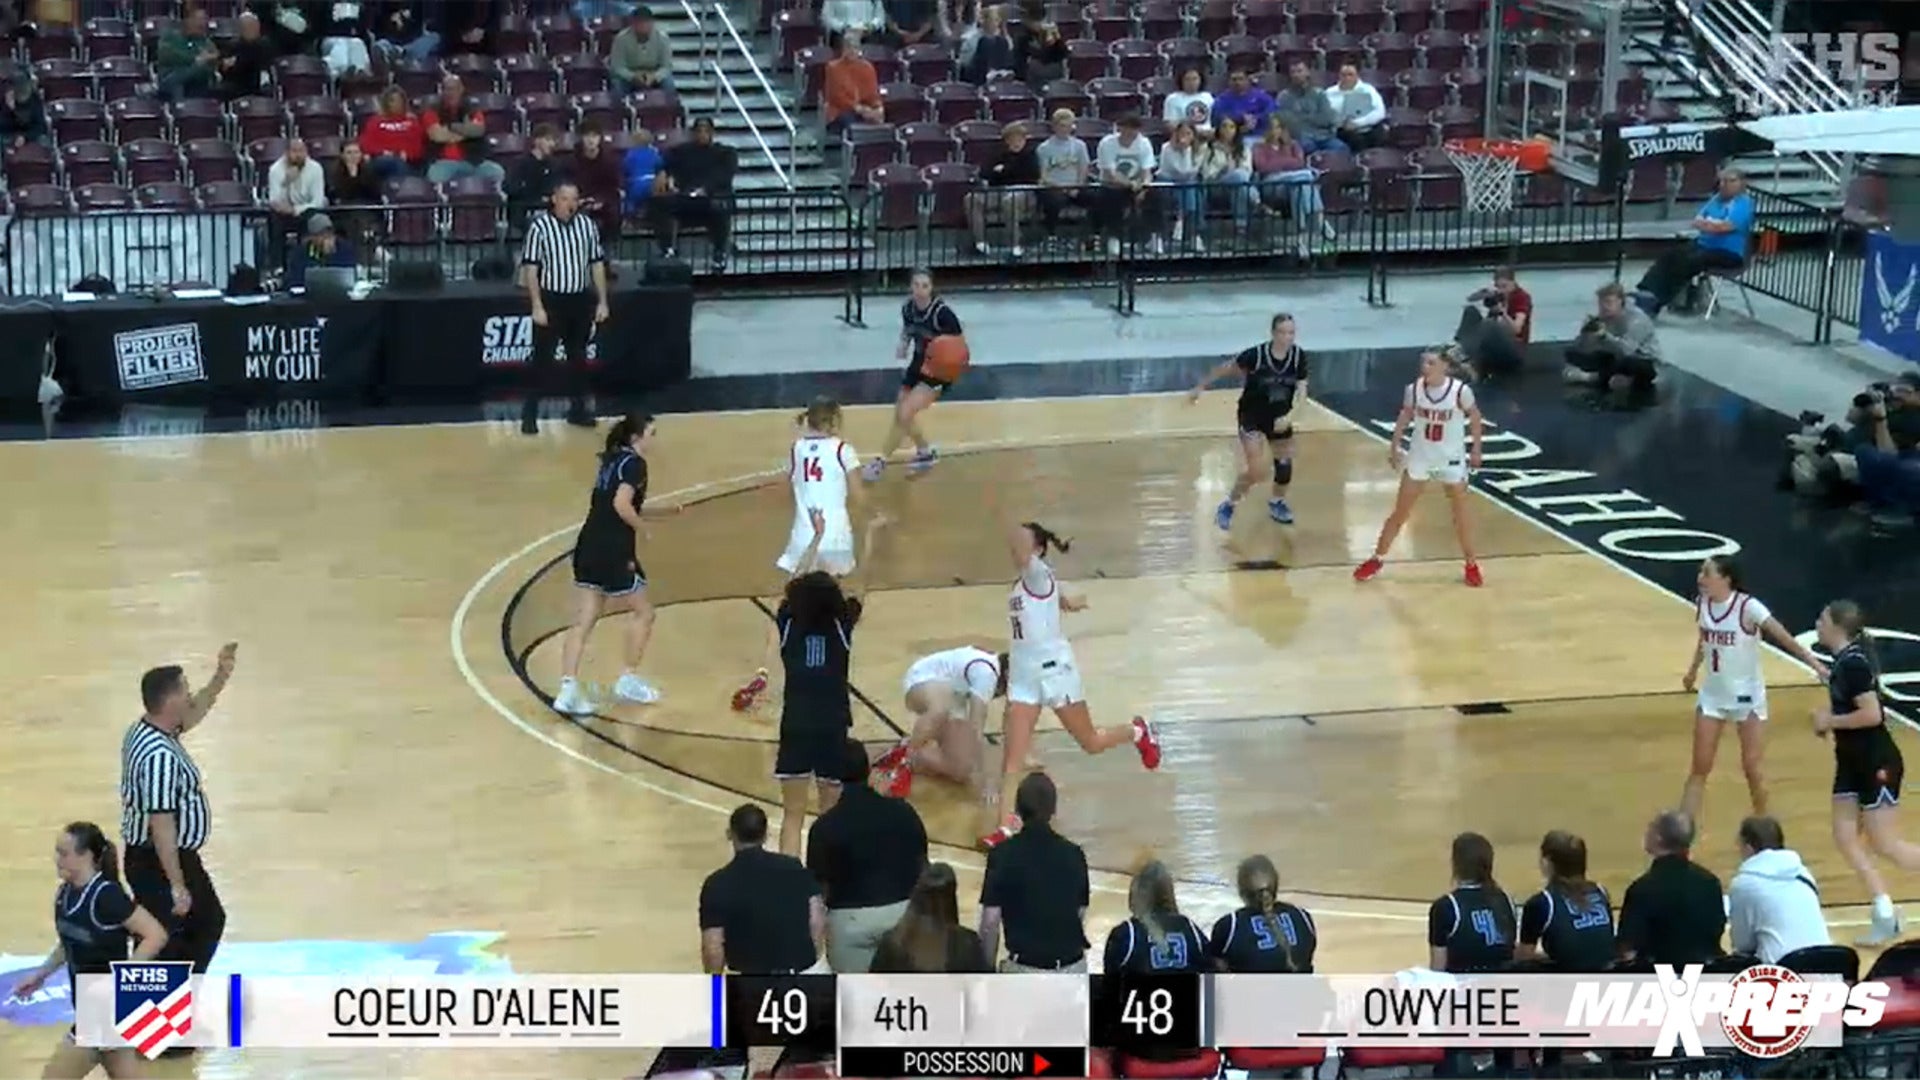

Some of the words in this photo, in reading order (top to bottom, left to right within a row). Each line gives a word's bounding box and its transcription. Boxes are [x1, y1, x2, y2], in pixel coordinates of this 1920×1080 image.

[1628, 132, 1705, 160] SPALDING
[119, 333, 196, 353] PROJECT
[247, 325, 277, 352] MY
[280, 326, 321, 355] LIFE
[482, 315, 534, 347] STA
[123, 350, 198, 377] FILTER
[244, 353, 272, 379] MY
[274, 353, 322, 381] QUIT
[803, 456, 823, 482] 14
[1711, 648, 1720, 673] 1
[1250, 911, 1298, 950] 54
[1148, 932, 1188, 970] 23
